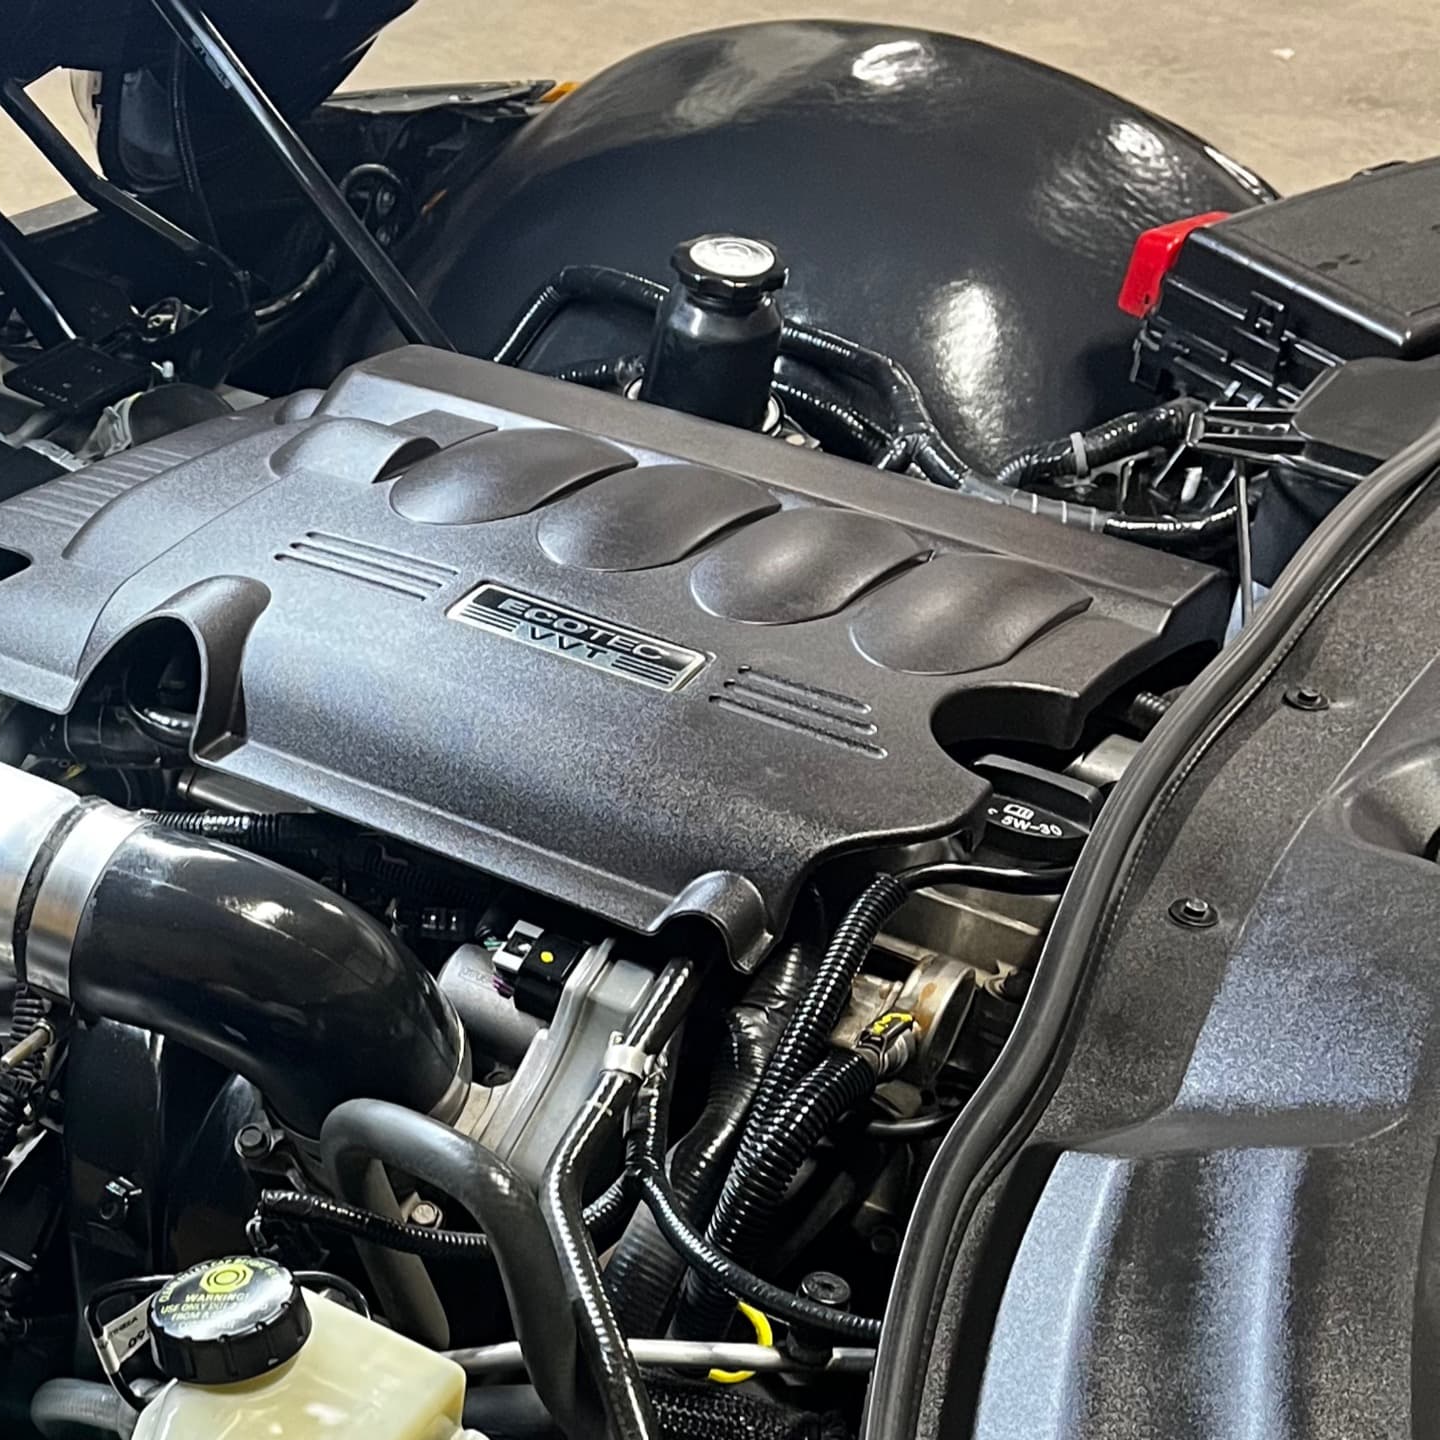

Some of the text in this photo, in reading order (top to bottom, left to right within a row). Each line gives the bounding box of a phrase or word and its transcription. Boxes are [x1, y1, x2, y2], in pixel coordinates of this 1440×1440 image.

[496, 598, 672, 661] ECOTEC
[529, 625, 609, 660] VVT
[1001, 815, 1063, 837] 5W-30
